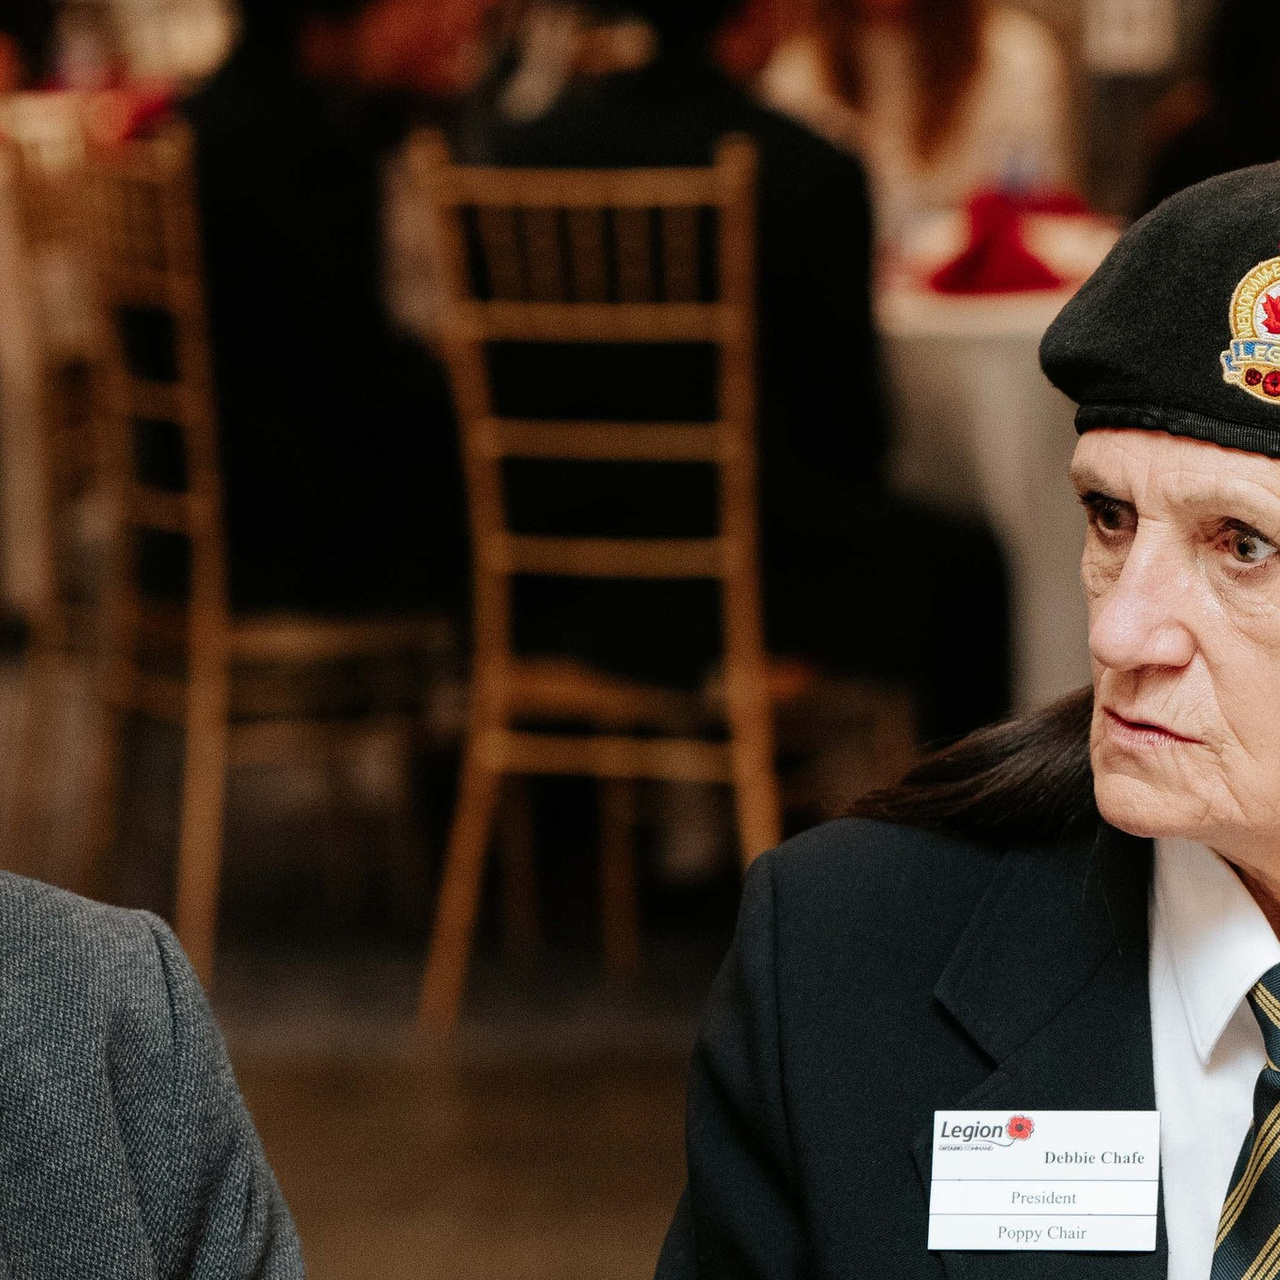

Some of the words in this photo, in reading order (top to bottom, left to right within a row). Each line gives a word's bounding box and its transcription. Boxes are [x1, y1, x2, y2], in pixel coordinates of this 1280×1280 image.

[941, 1121, 1003, 1142] Legion
[1044, 1151, 1096, 1164] Debbie
[1101, 1151, 1145, 1164] Chafe
[1011, 1191, 1077, 1204] President
[998, 1226, 1043, 1242] Poppy
[1047, 1226, 1088, 1240] Chair
